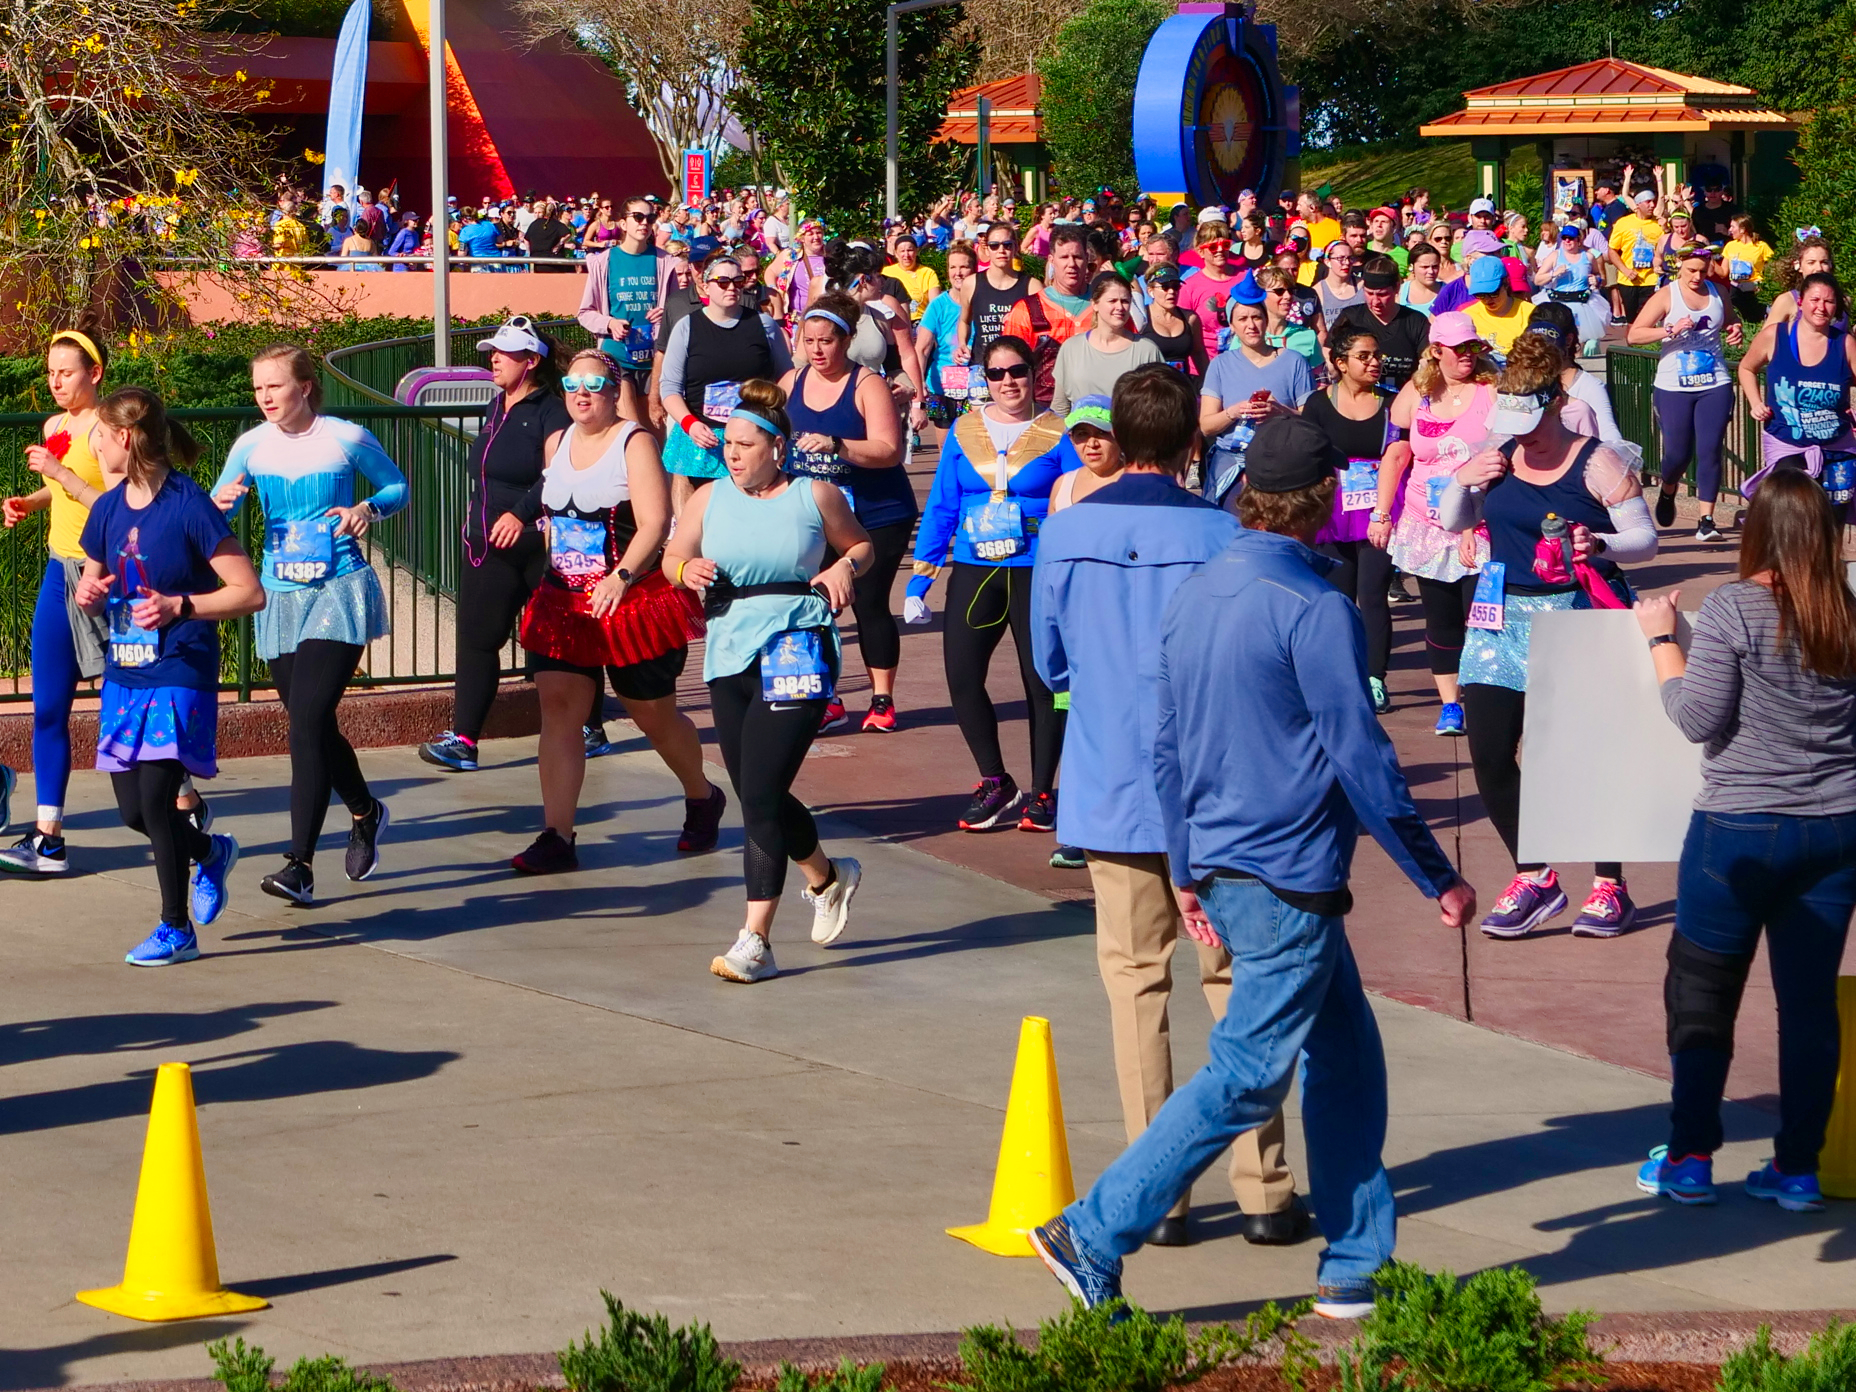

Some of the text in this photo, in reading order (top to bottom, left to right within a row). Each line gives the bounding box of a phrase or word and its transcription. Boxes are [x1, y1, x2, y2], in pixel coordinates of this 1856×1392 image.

[989, 304, 1012, 312] RUN
[979, 314, 997, 323] LIKE
[1798, 380, 1842, 391] FORGET THE
[976, 538, 1016, 558] 3680
[276, 562, 326, 580] 14382
[112, 643, 155, 662] 14604
[773, 674, 822, 695] 9845
